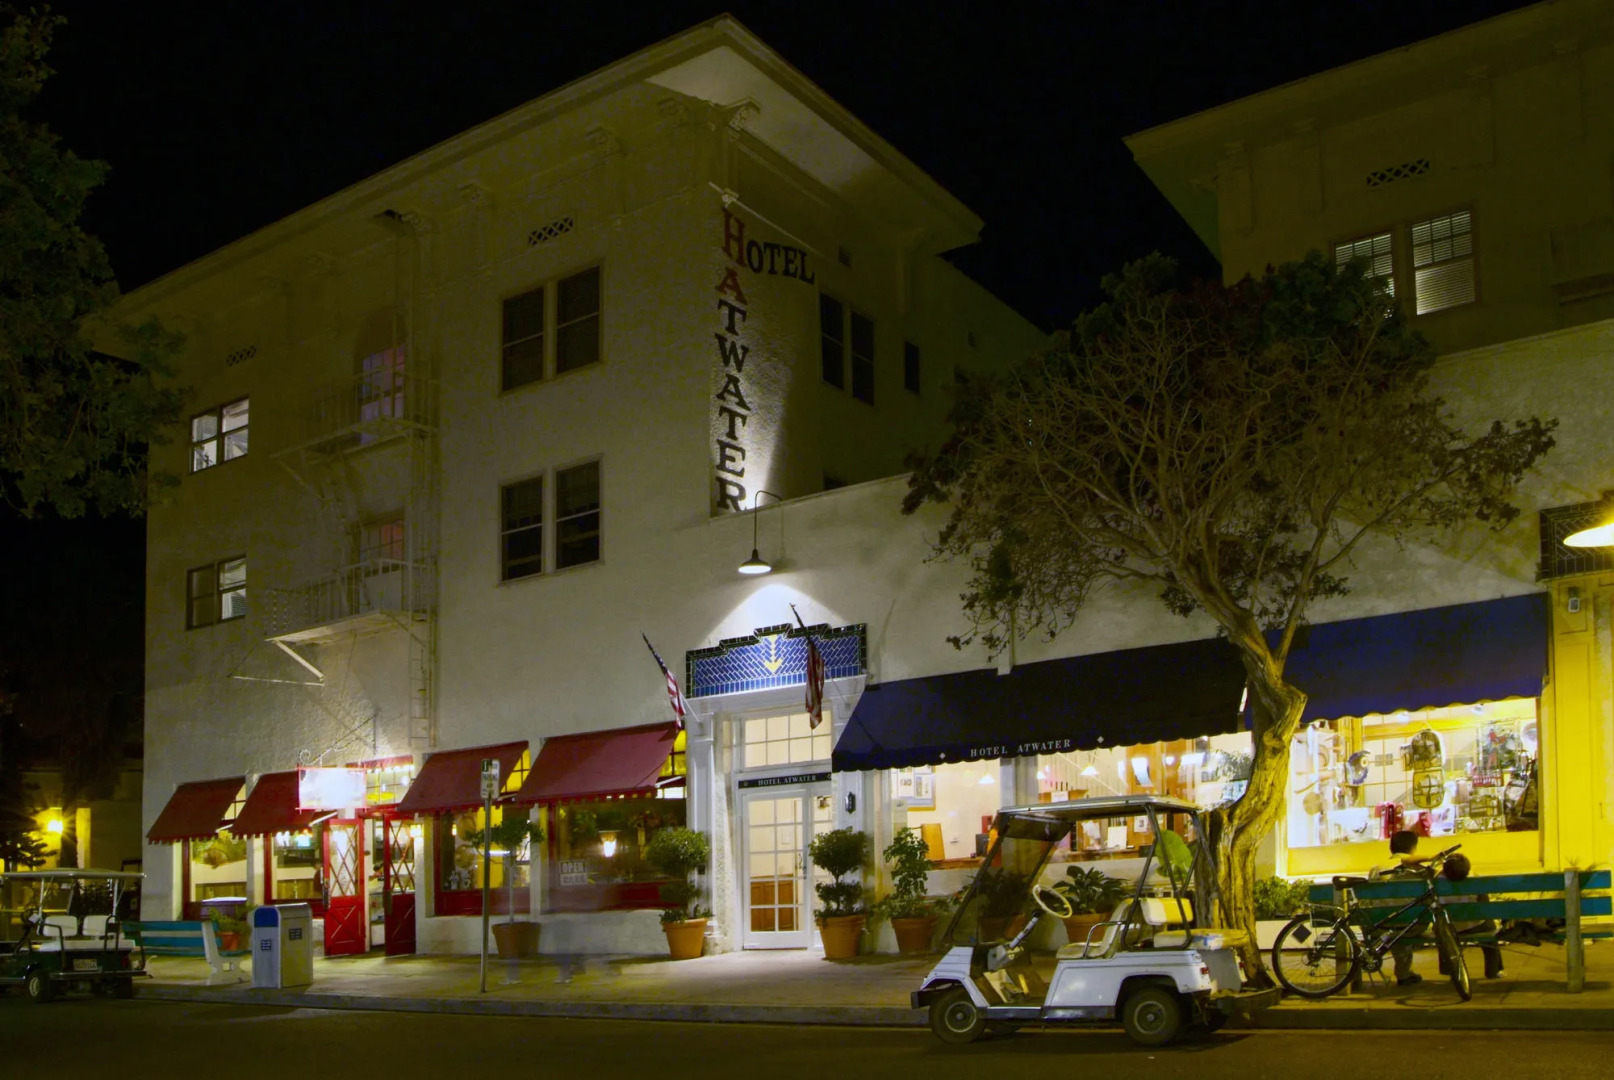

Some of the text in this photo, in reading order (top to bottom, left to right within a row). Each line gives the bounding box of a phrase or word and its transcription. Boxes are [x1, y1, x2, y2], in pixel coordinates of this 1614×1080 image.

[722, 206, 815, 284] HOTEL
[714, 267, 750, 512] ATWATER
[970, 739, 1071, 757] HOTEL ATWATER
[758, 775, 817, 786] HOTEL ATWATER
[562, 862, 584, 873] OPEN
